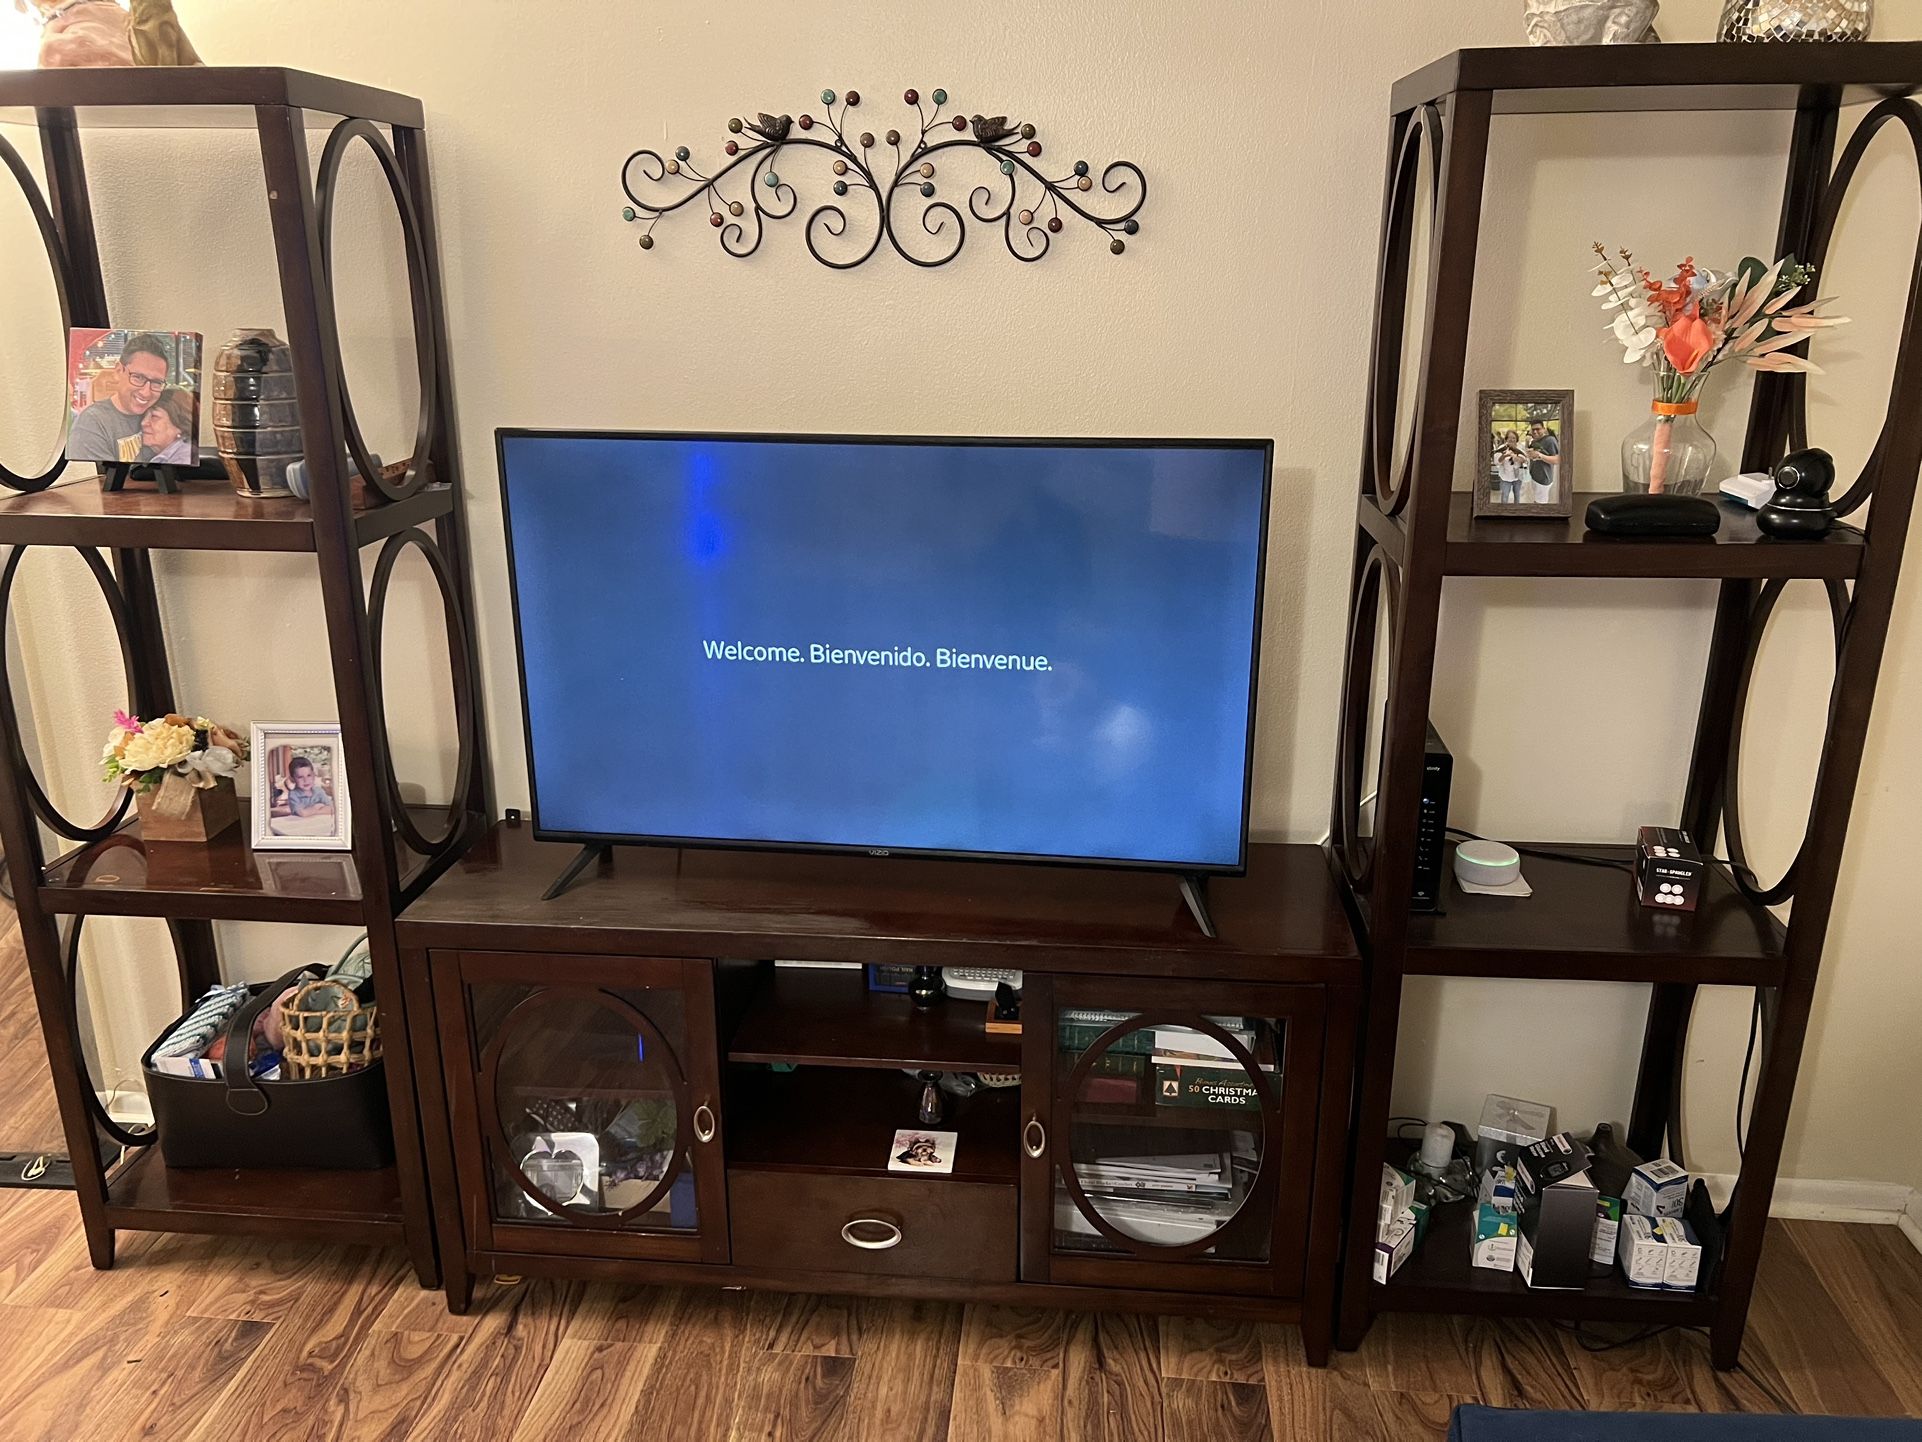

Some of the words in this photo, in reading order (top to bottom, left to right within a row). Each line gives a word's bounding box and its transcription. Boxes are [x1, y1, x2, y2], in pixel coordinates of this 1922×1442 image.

[703, 640, 804, 662] Welcome.
[810, 644, 930, 667] Bienvenido.
[937, 648, 1052, 671] Bienvenue.
[1188, 1085, 1200, 1093] 50
[1202, 1086, 1258, 1096] CHRISTMA
[1208, 1095, 1246, 1104] CARDS
